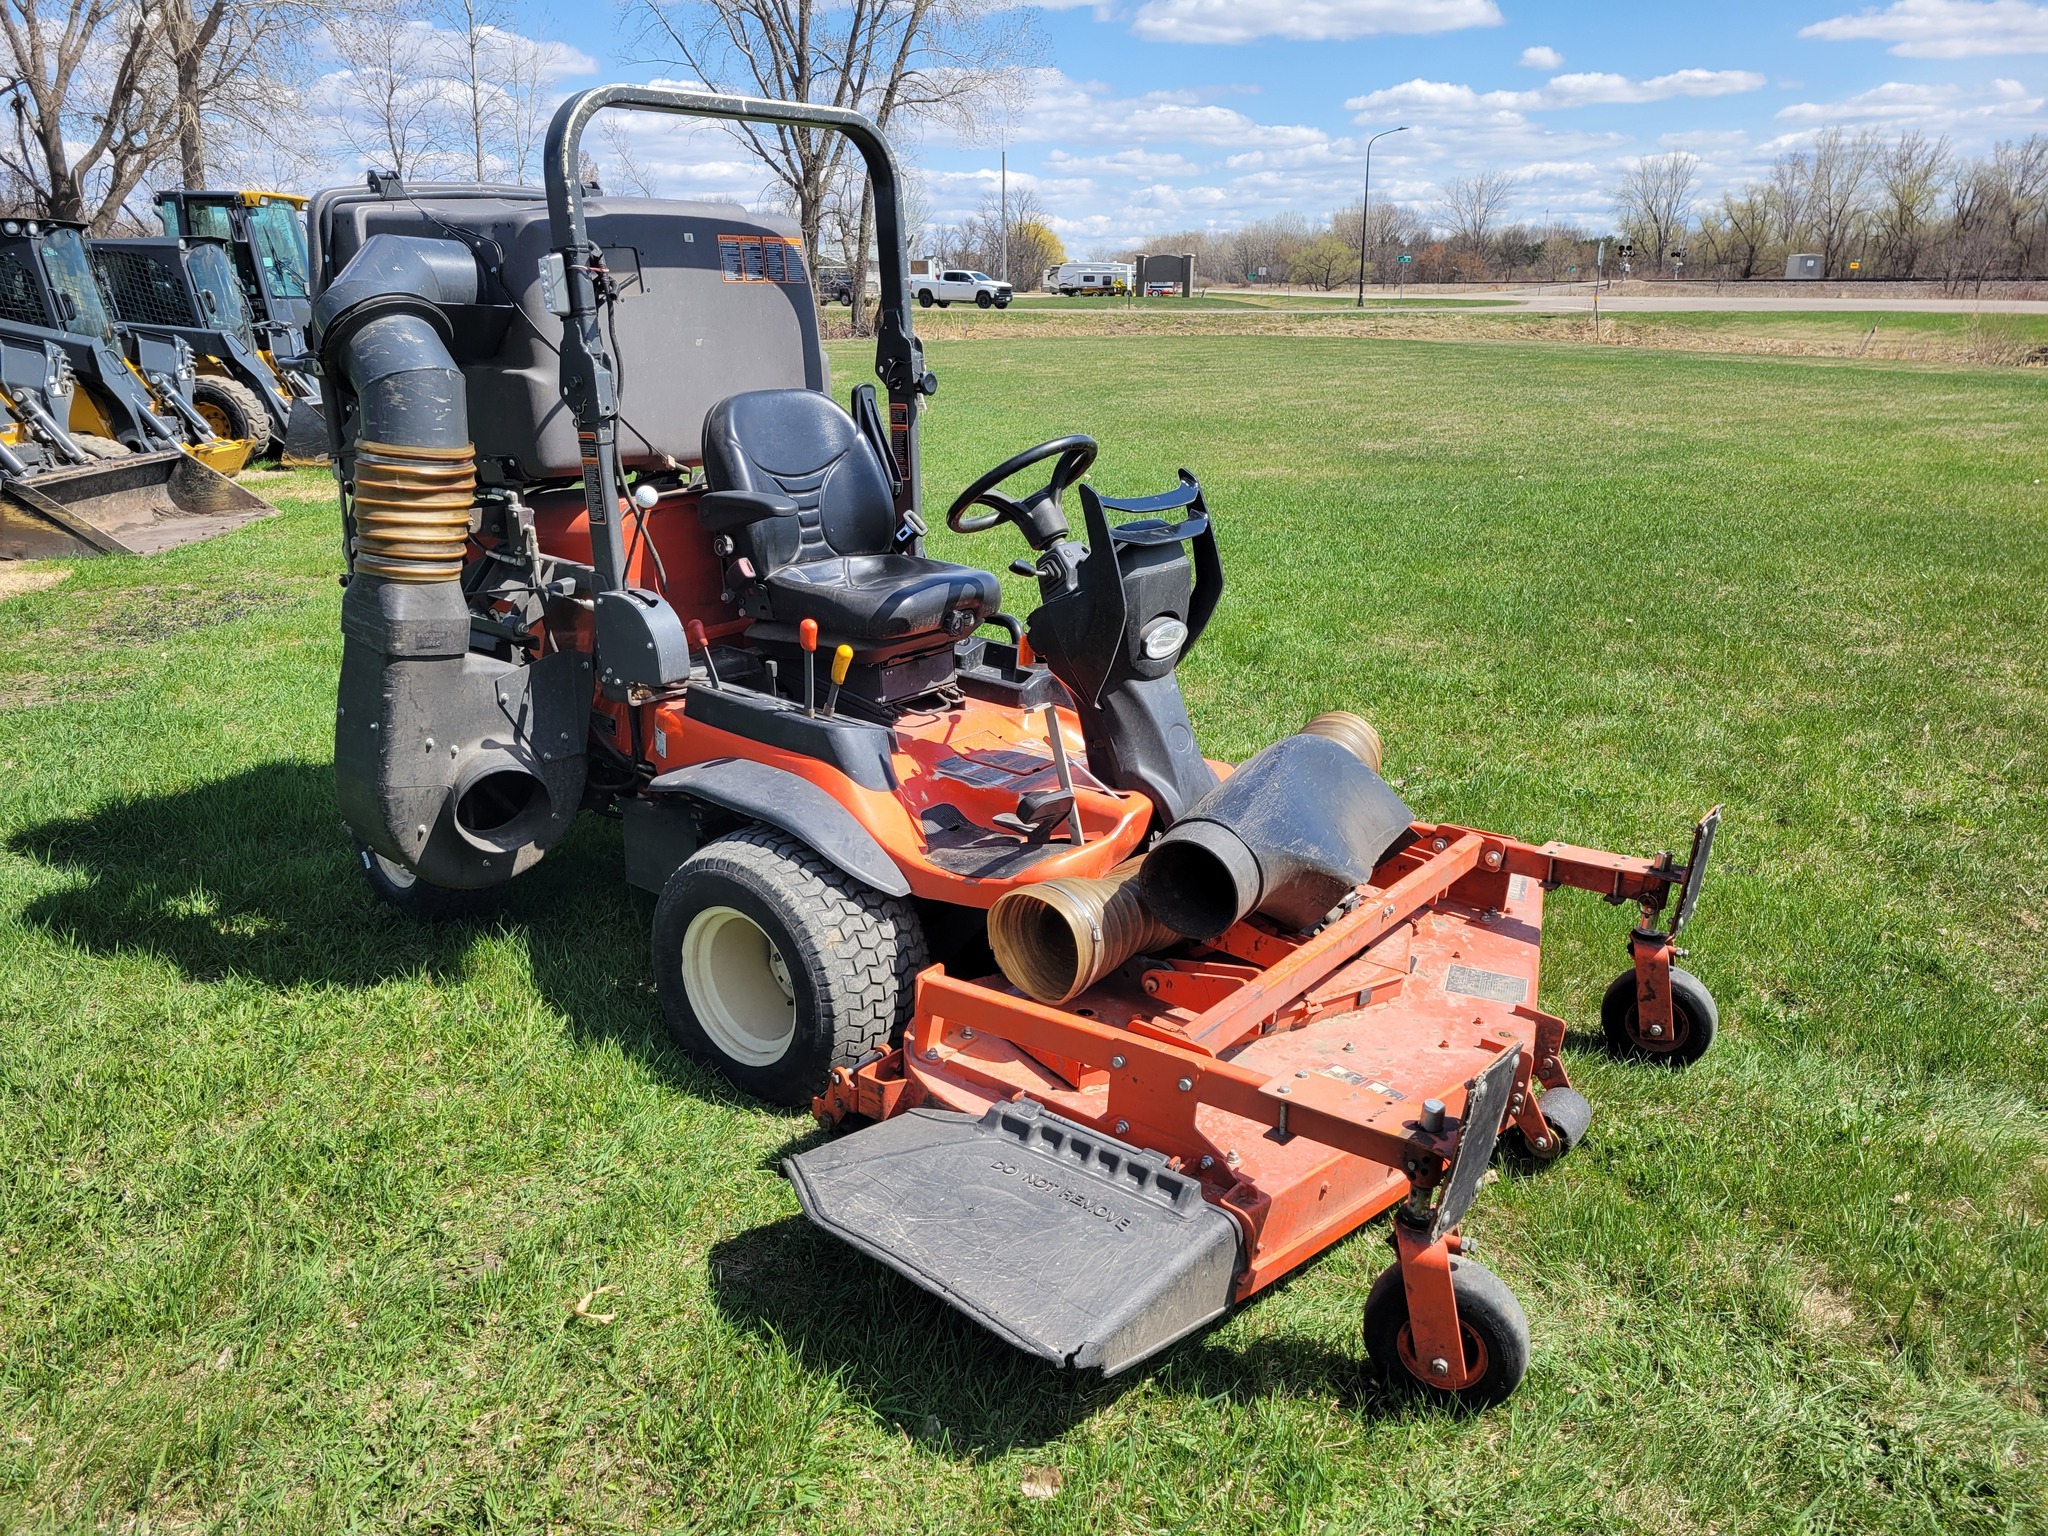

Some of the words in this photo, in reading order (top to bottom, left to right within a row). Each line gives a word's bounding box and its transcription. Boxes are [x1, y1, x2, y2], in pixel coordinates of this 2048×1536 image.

[990, 1159, 1019, 1176] DO
[1021, 1172, 1060, 1193] NOT
[1058, 1188, 1132, 1233] REMOVE
